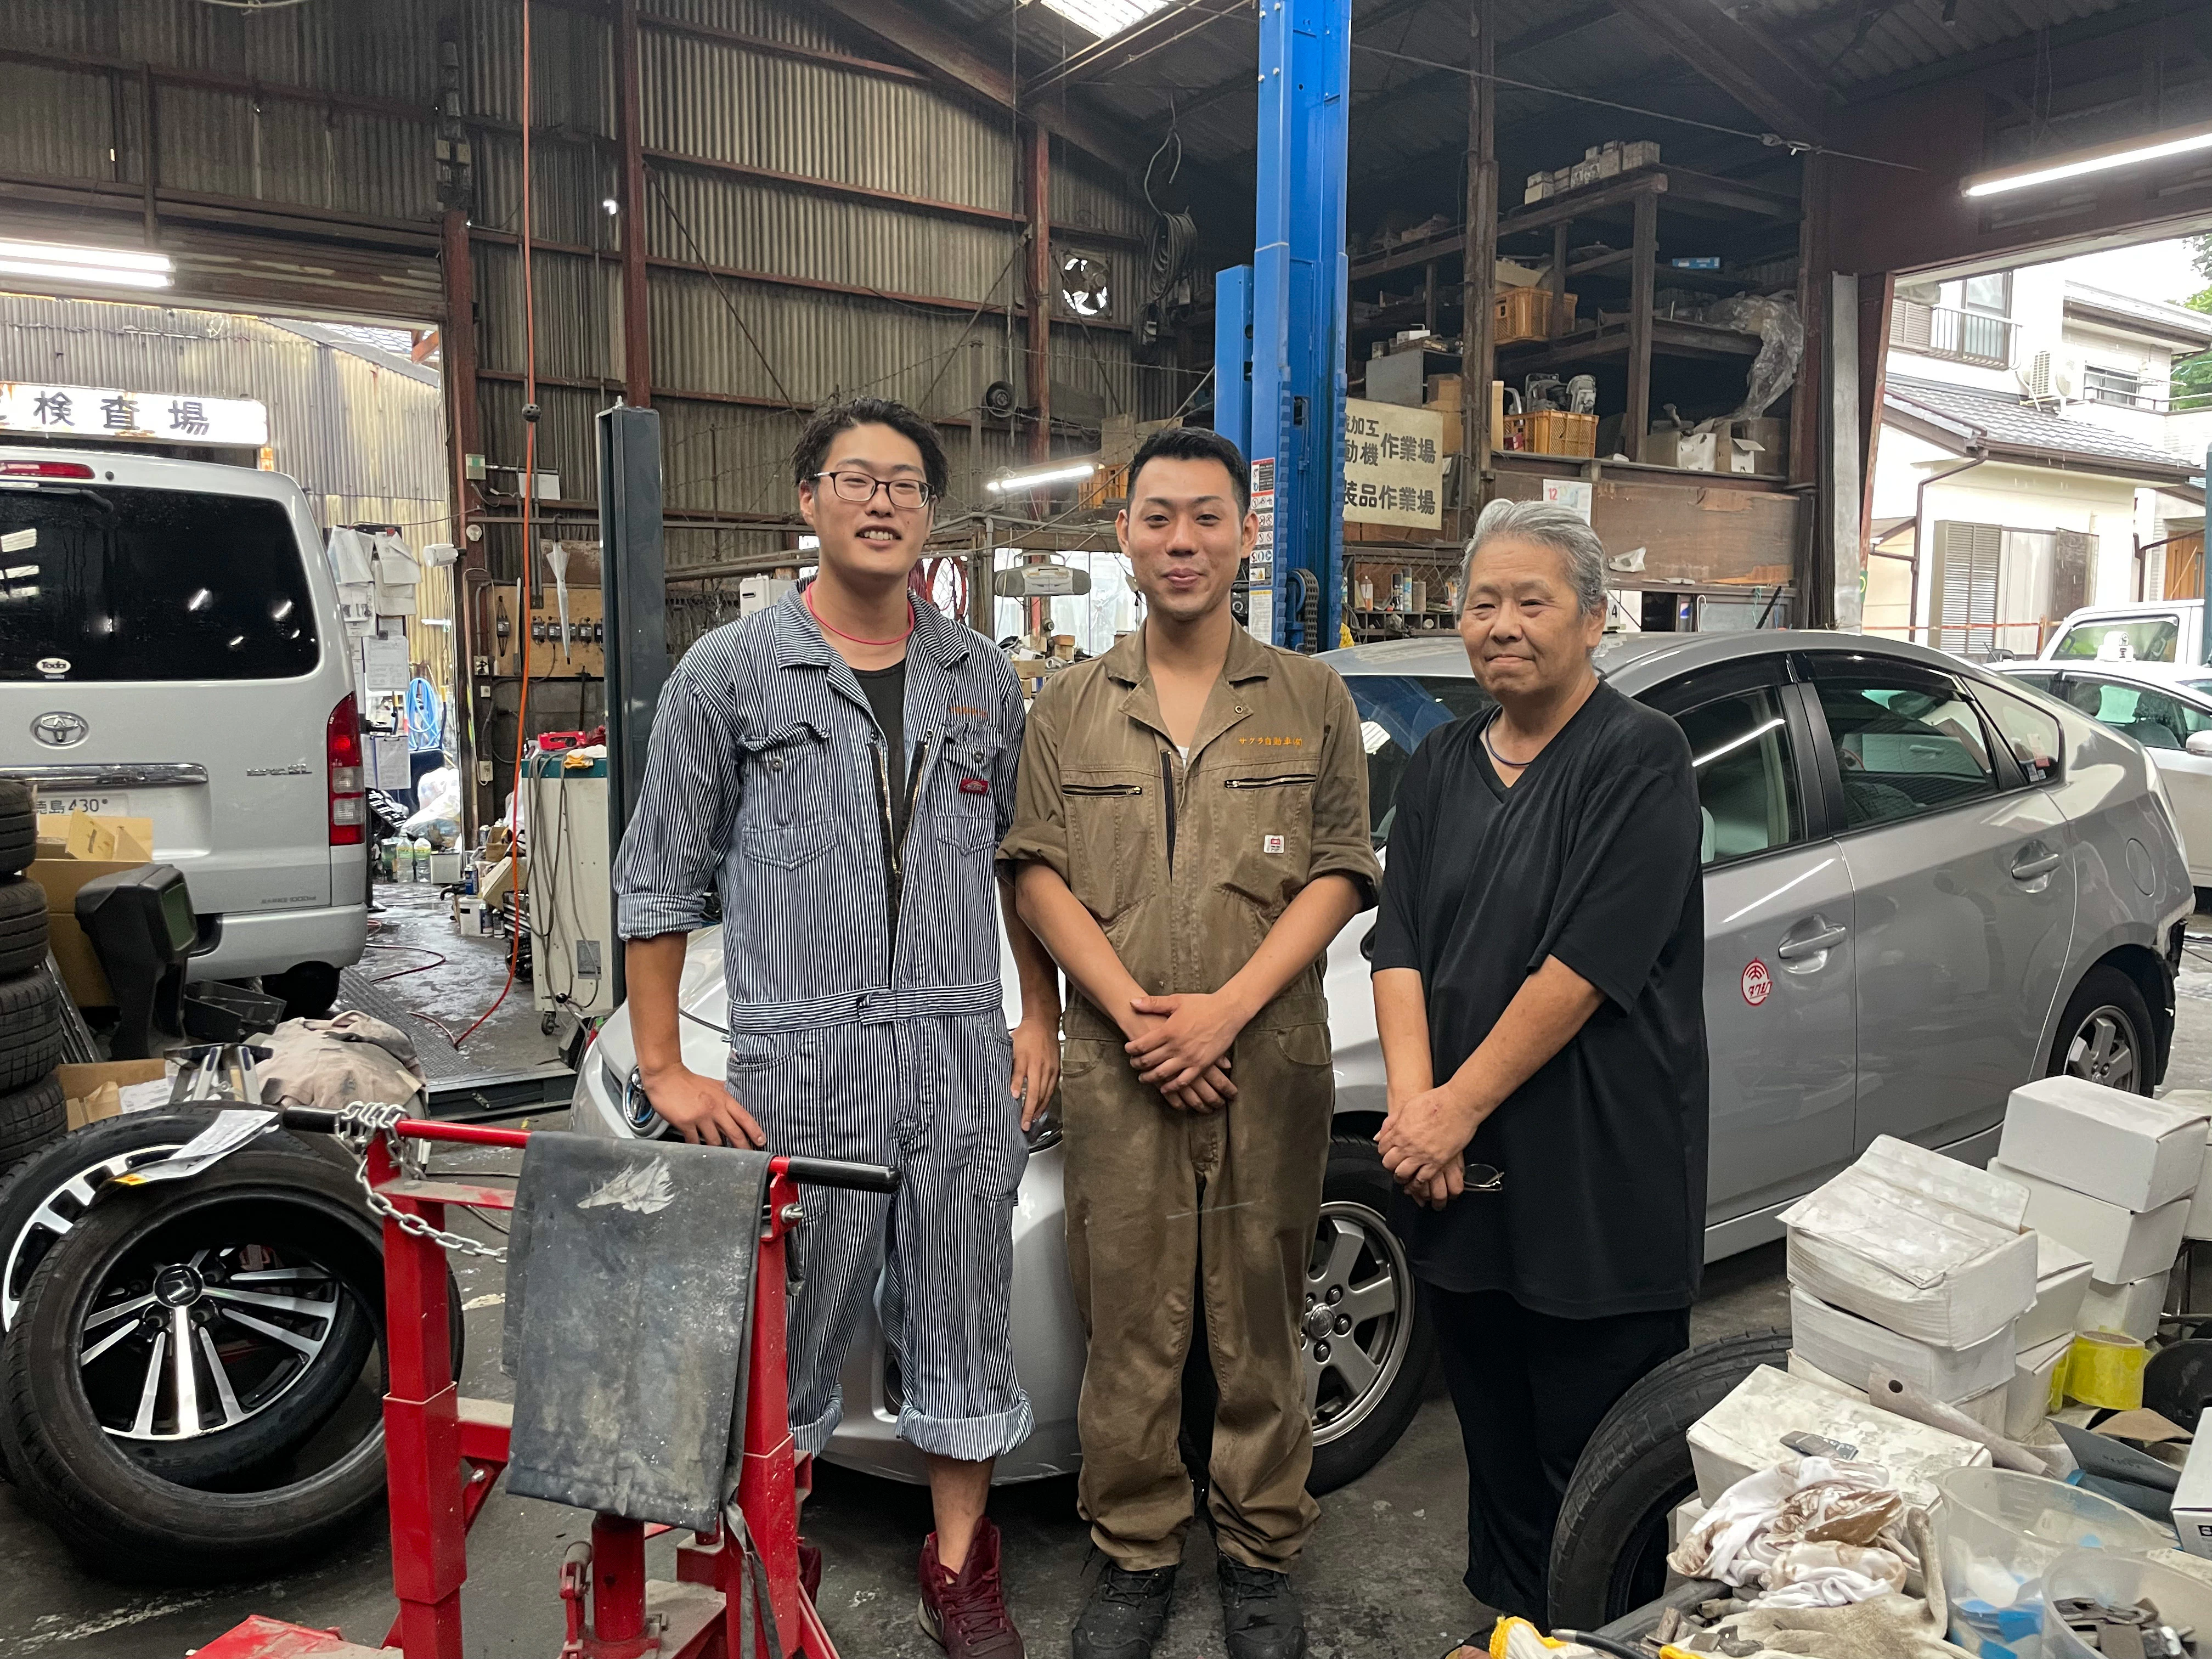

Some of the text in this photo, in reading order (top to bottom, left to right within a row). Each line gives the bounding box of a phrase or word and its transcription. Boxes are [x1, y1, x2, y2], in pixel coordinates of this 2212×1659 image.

[0, 388, 210, 436] 検査場
[1380, 432, 1436, 464] 作業場
[1549, 488, 1558, 500] 12
[68, 799, 99, 812] 430
